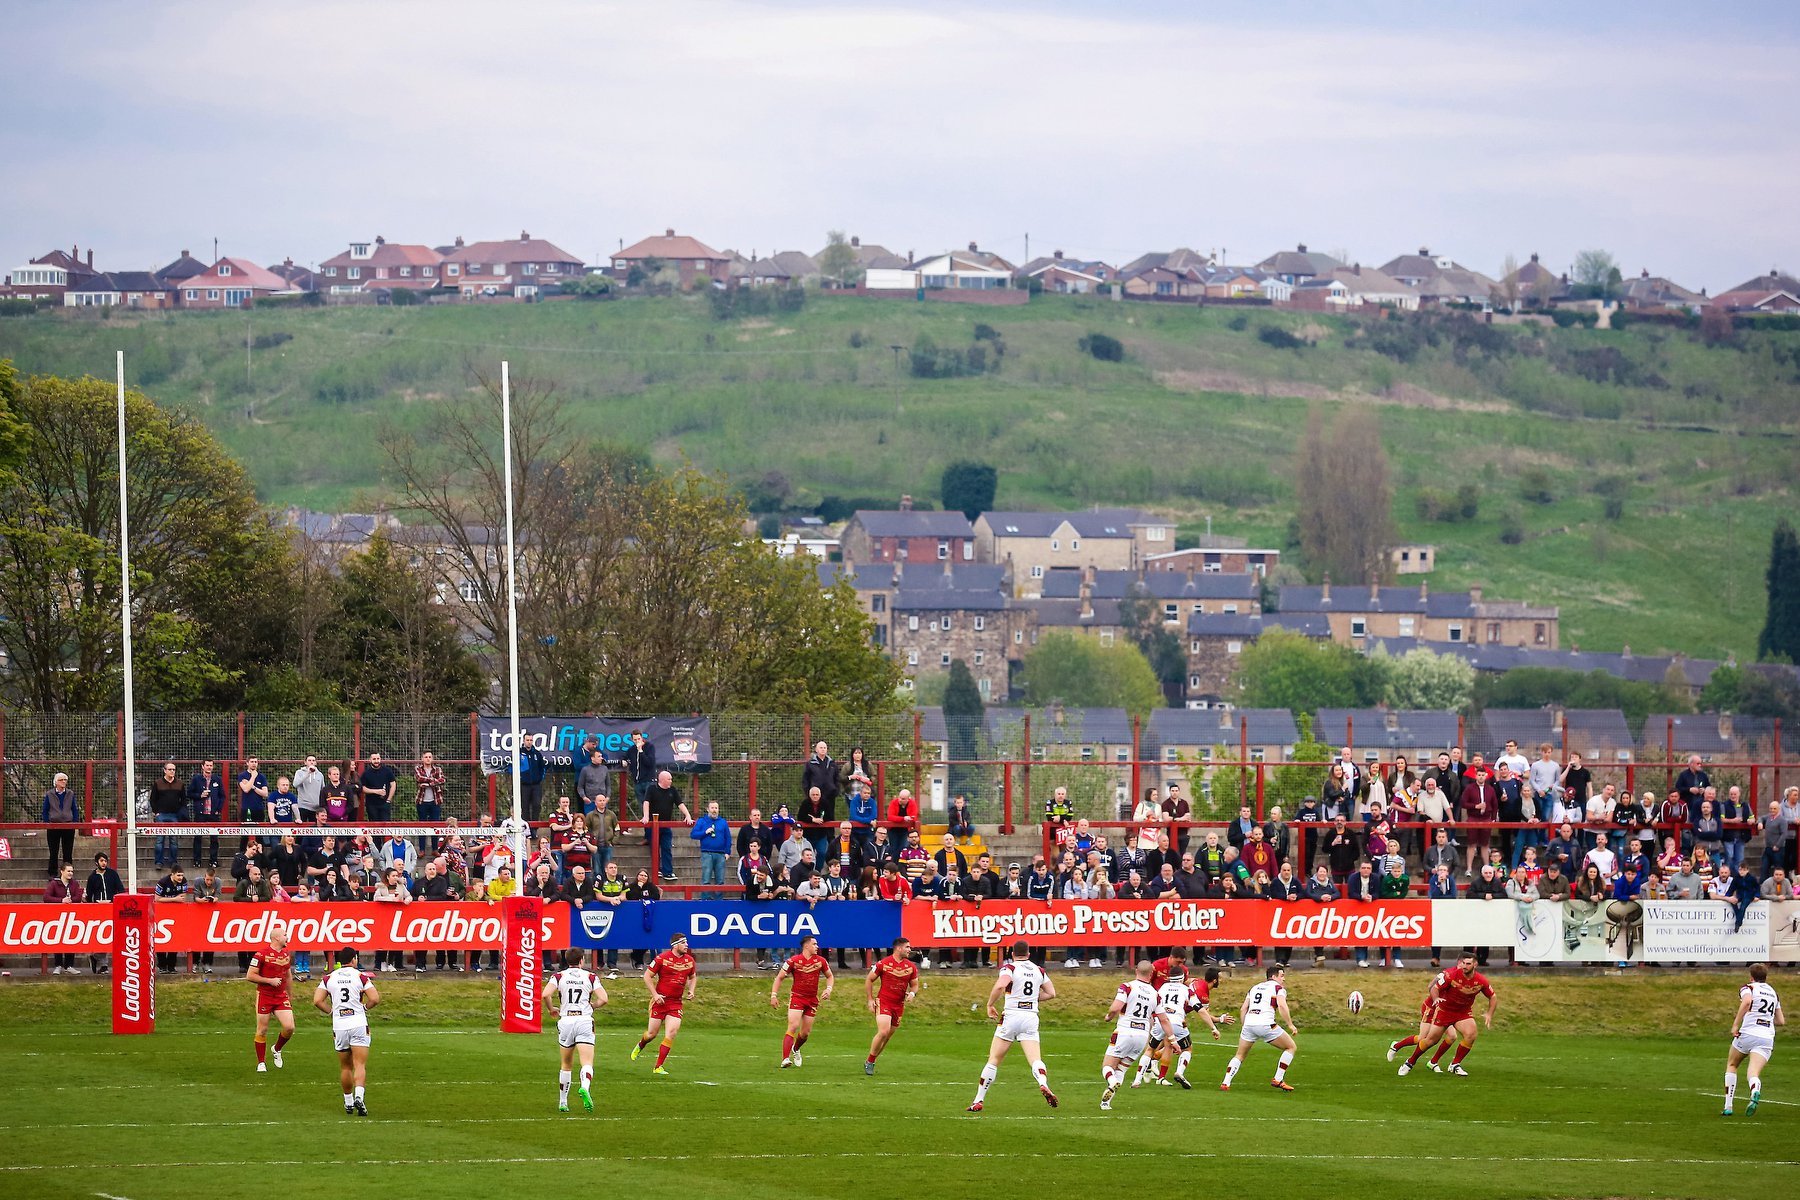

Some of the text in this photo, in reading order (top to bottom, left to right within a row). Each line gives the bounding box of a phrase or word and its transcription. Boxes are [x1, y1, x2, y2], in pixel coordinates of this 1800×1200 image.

[552, 755, 572, 766] 100
[1647, 907, 1767, 922] WESTCLIFFE JOERS
[3, 911, 175, 945] Ladbros
[206, 910, 375, 944] Ladbrokes
[389, 910, 555, 943] Ladbros
[690, 913, 821, 936] DACIA
[932, 902, 1225, 944] Kingstone Press Cider
[1269, 907, 1425, 940] Ladbrokes
[1713, 928, 1757, 936] STAIRASES
[1646, 944, 1767, 956] www.westcliffejoiners.co.uk
[121, 925, 140, 1022] Ladbrokes
[515, 926, 536, 1021] Ladbrokes
[340, 987, 350, 1003] 3
[568, 988, 583, 1004] 17
[1023, 981, 1033, 996] 8
[1164, 993, 1179, 1005] 14
[1253, 992, 1263, 1004] 9
[1132, 1002, 1149, 1018] 21
[1757, 998, 1775, 1017] 24
